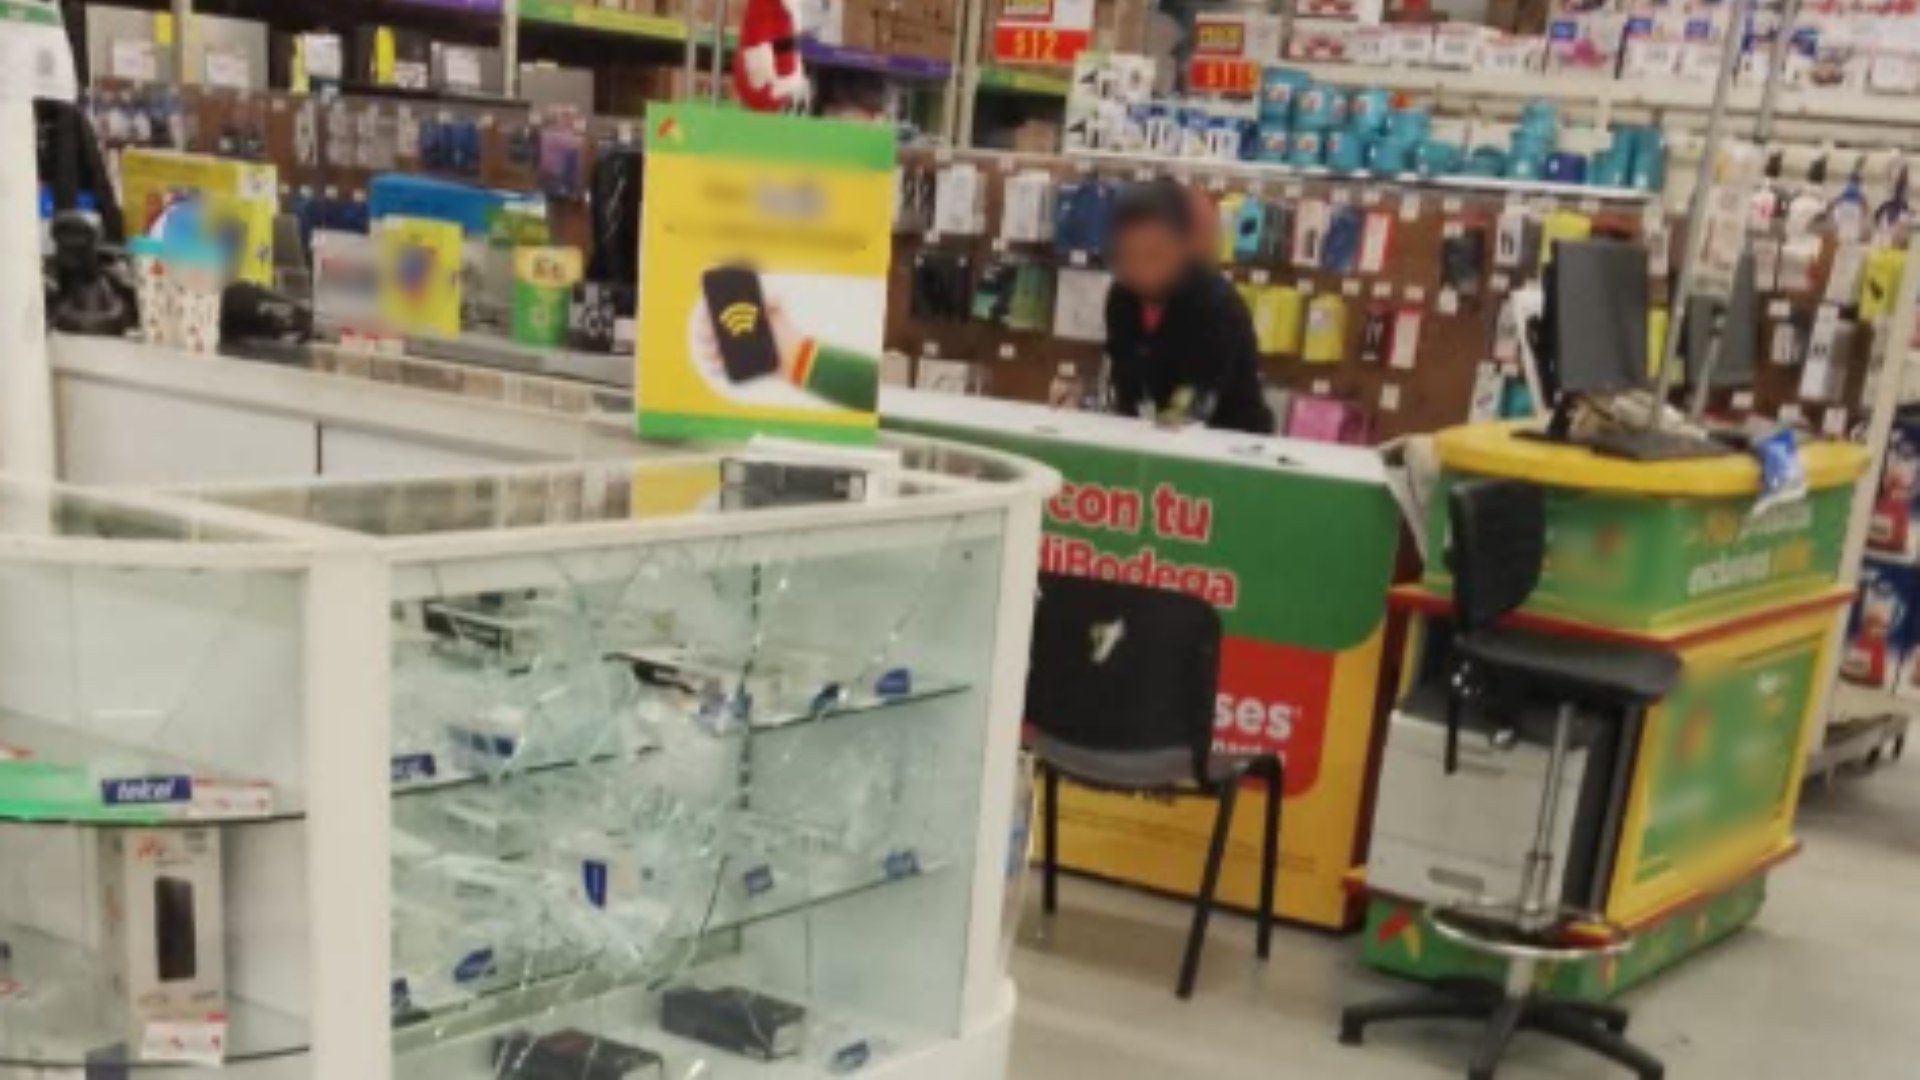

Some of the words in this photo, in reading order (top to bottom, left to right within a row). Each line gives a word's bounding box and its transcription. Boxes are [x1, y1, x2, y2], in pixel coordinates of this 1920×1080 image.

[1047, 483, 1141, 535] con
[1153, 481, 1212, 543] tu
[1212, 692, 1293, 741] ses
[116, 776, 176, 801] telcel
